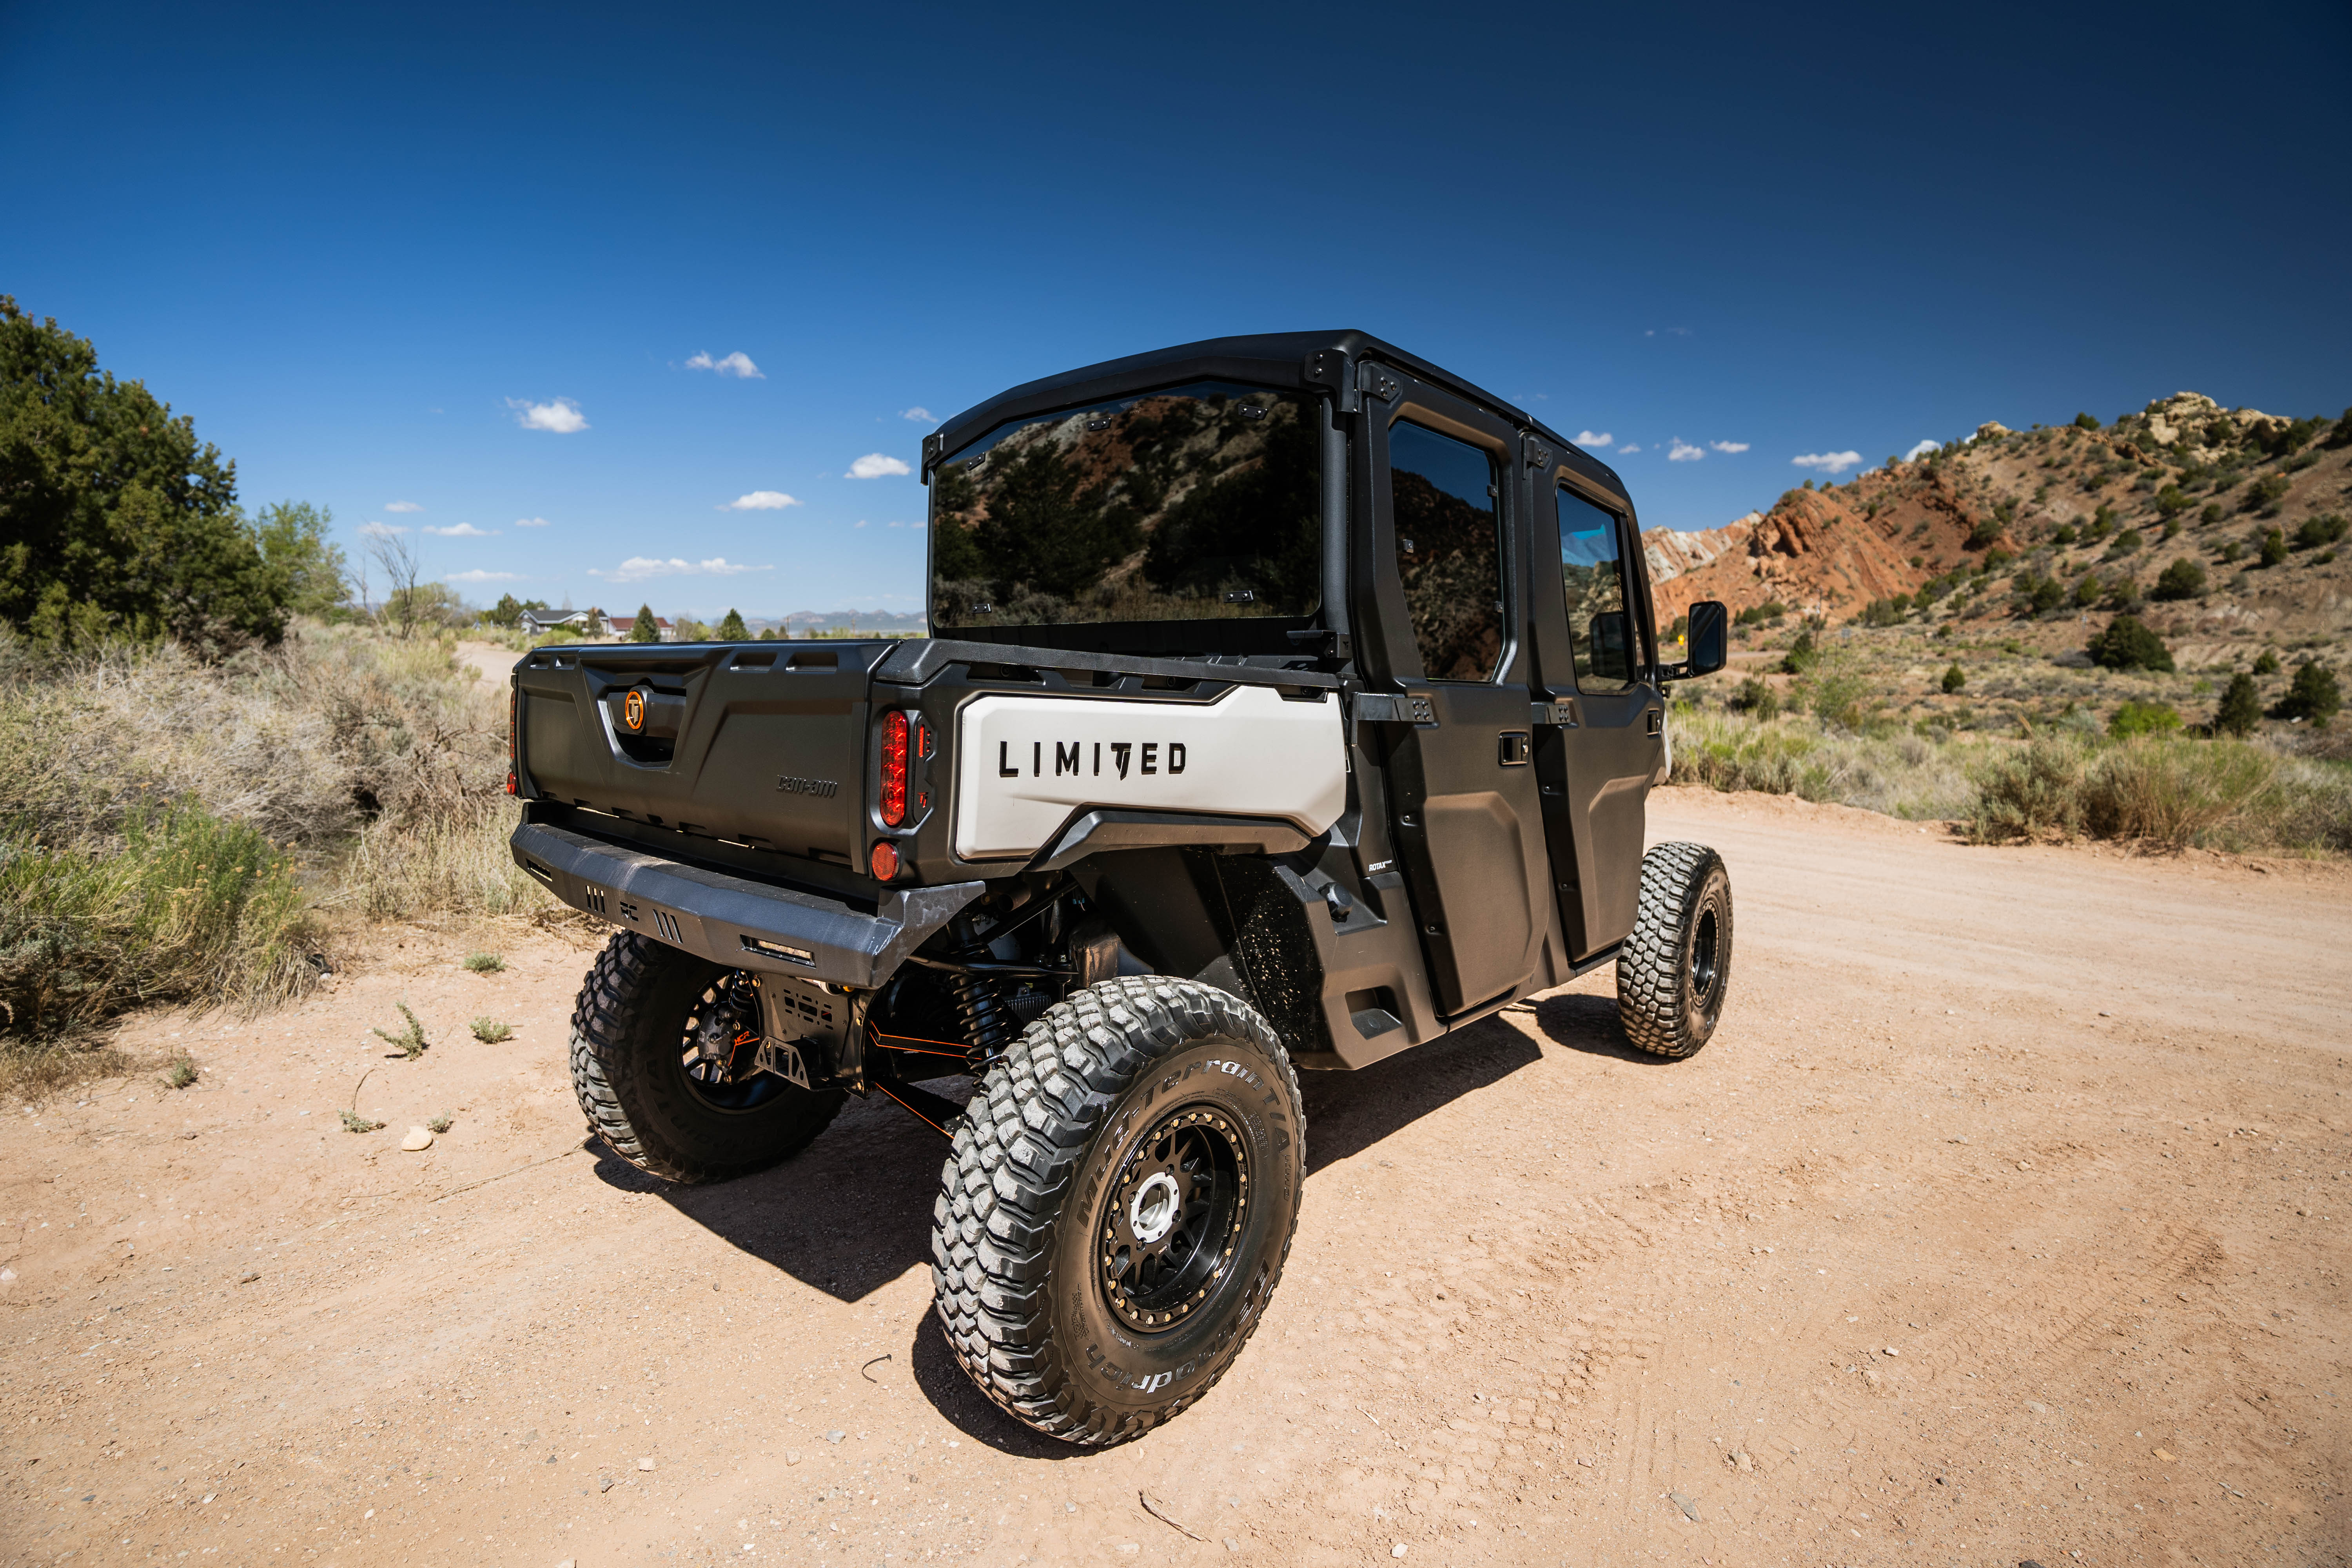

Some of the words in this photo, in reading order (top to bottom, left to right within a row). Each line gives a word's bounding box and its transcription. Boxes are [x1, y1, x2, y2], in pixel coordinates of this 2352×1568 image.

[999, 741, 1186, 781] LIMITED
[777, 776, 837, 798] can-am
[1369, 862, 1386, 871] ROTAX
[734, 1031, 750, 1045] HCR
[1077, 1059, 1264, 1228] Mud-Terrain
[1086, 1258, 1270, 1394] BFGoodrich
